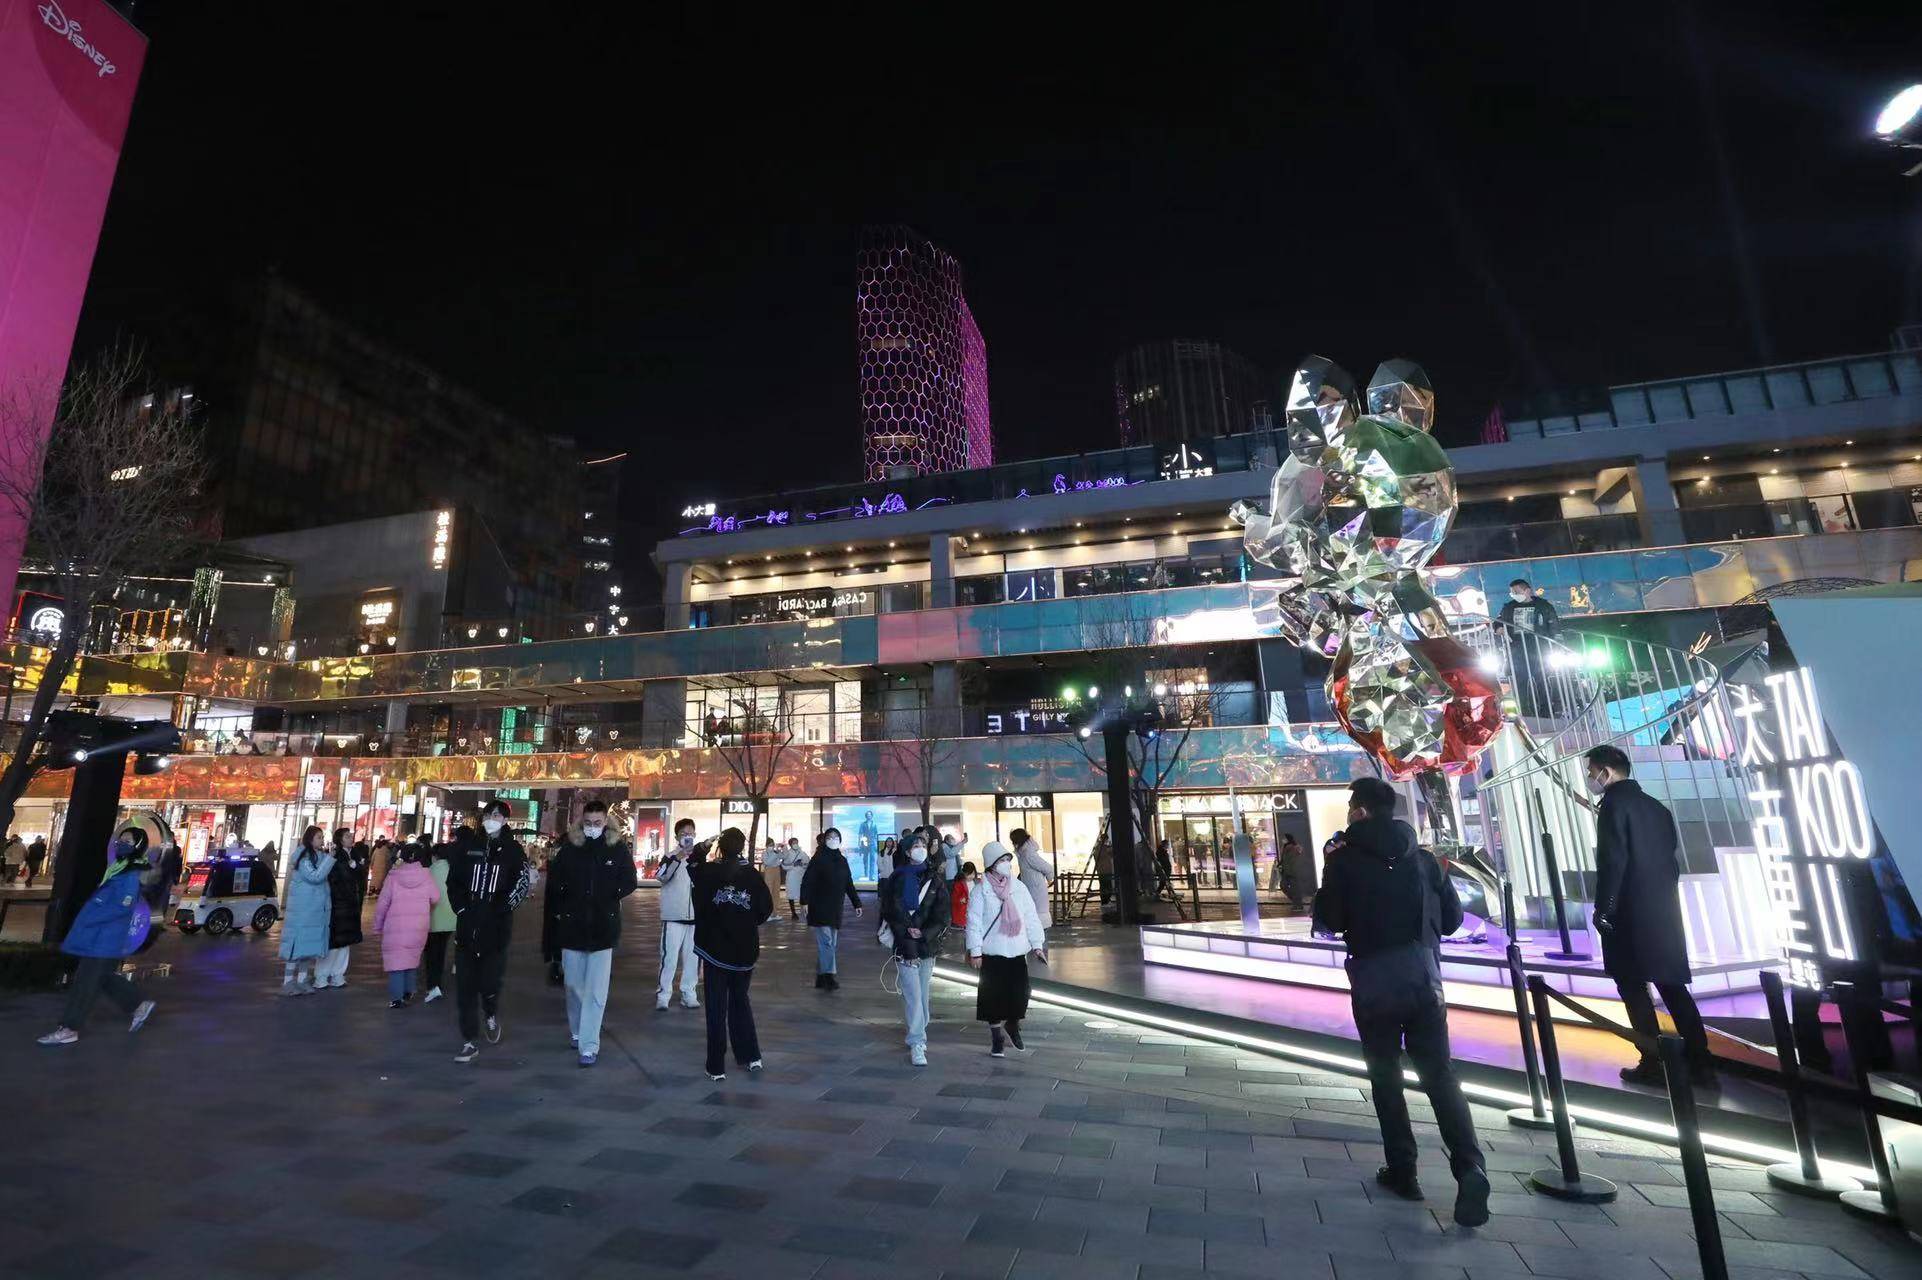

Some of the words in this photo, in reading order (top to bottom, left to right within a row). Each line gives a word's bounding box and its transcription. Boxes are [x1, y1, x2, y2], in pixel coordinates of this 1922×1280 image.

[1765, 666, 1829, 761] TAI
[729, 800, 753, 813] DIO
[1005, 795, 1043, 809] DIOR
[1734, 683, 1815, 957] 太古里
[1789, 760, 1872, 859] KOO
[1808, 863, 1854, 960] LI
